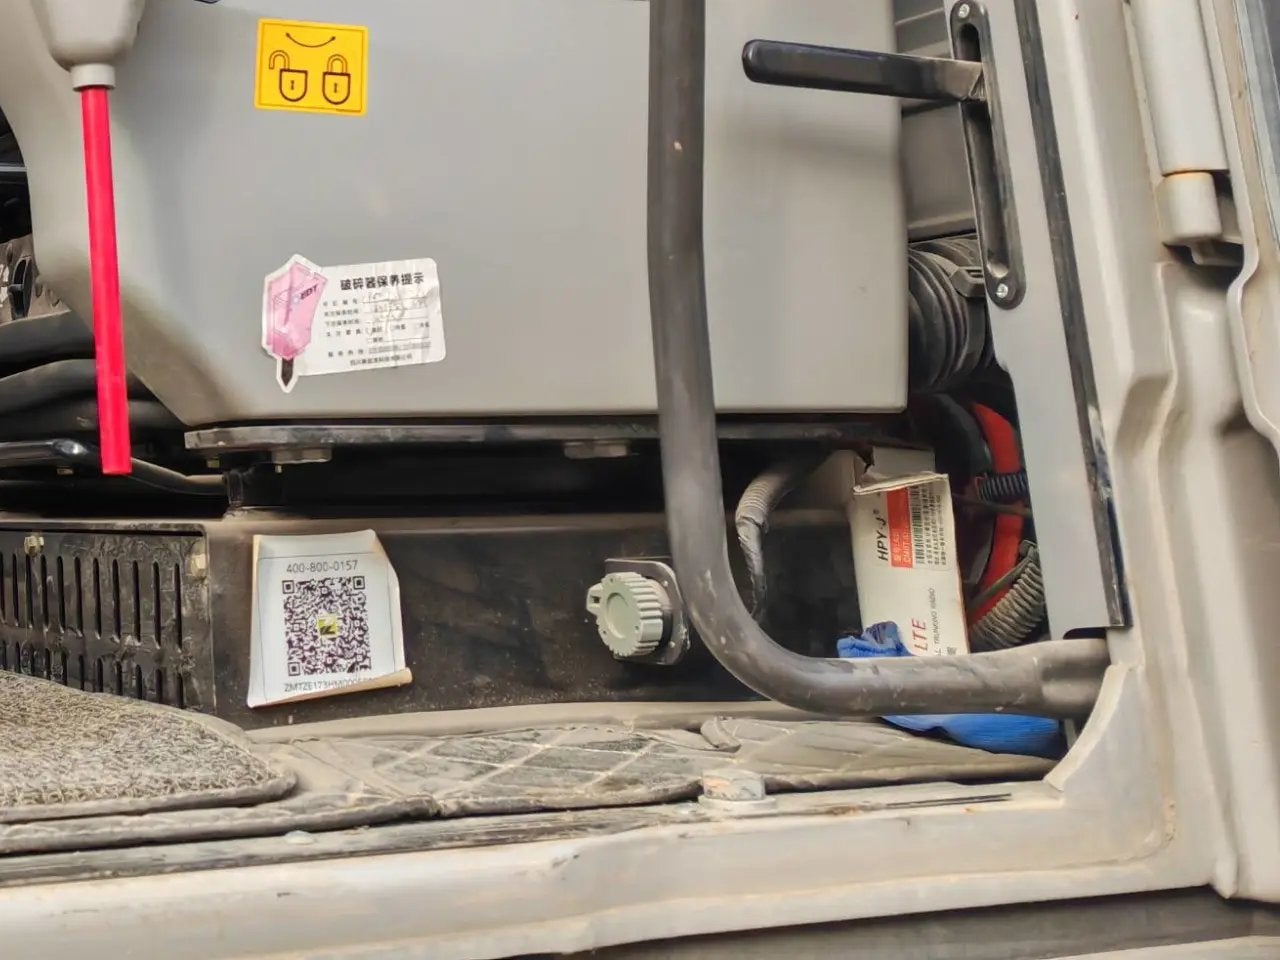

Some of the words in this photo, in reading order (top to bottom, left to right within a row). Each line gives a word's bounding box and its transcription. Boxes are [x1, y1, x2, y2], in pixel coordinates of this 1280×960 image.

[340, 272, 425, 291] 破碎器保养提示
[286, 560, 358, 573] 400-800-0157
